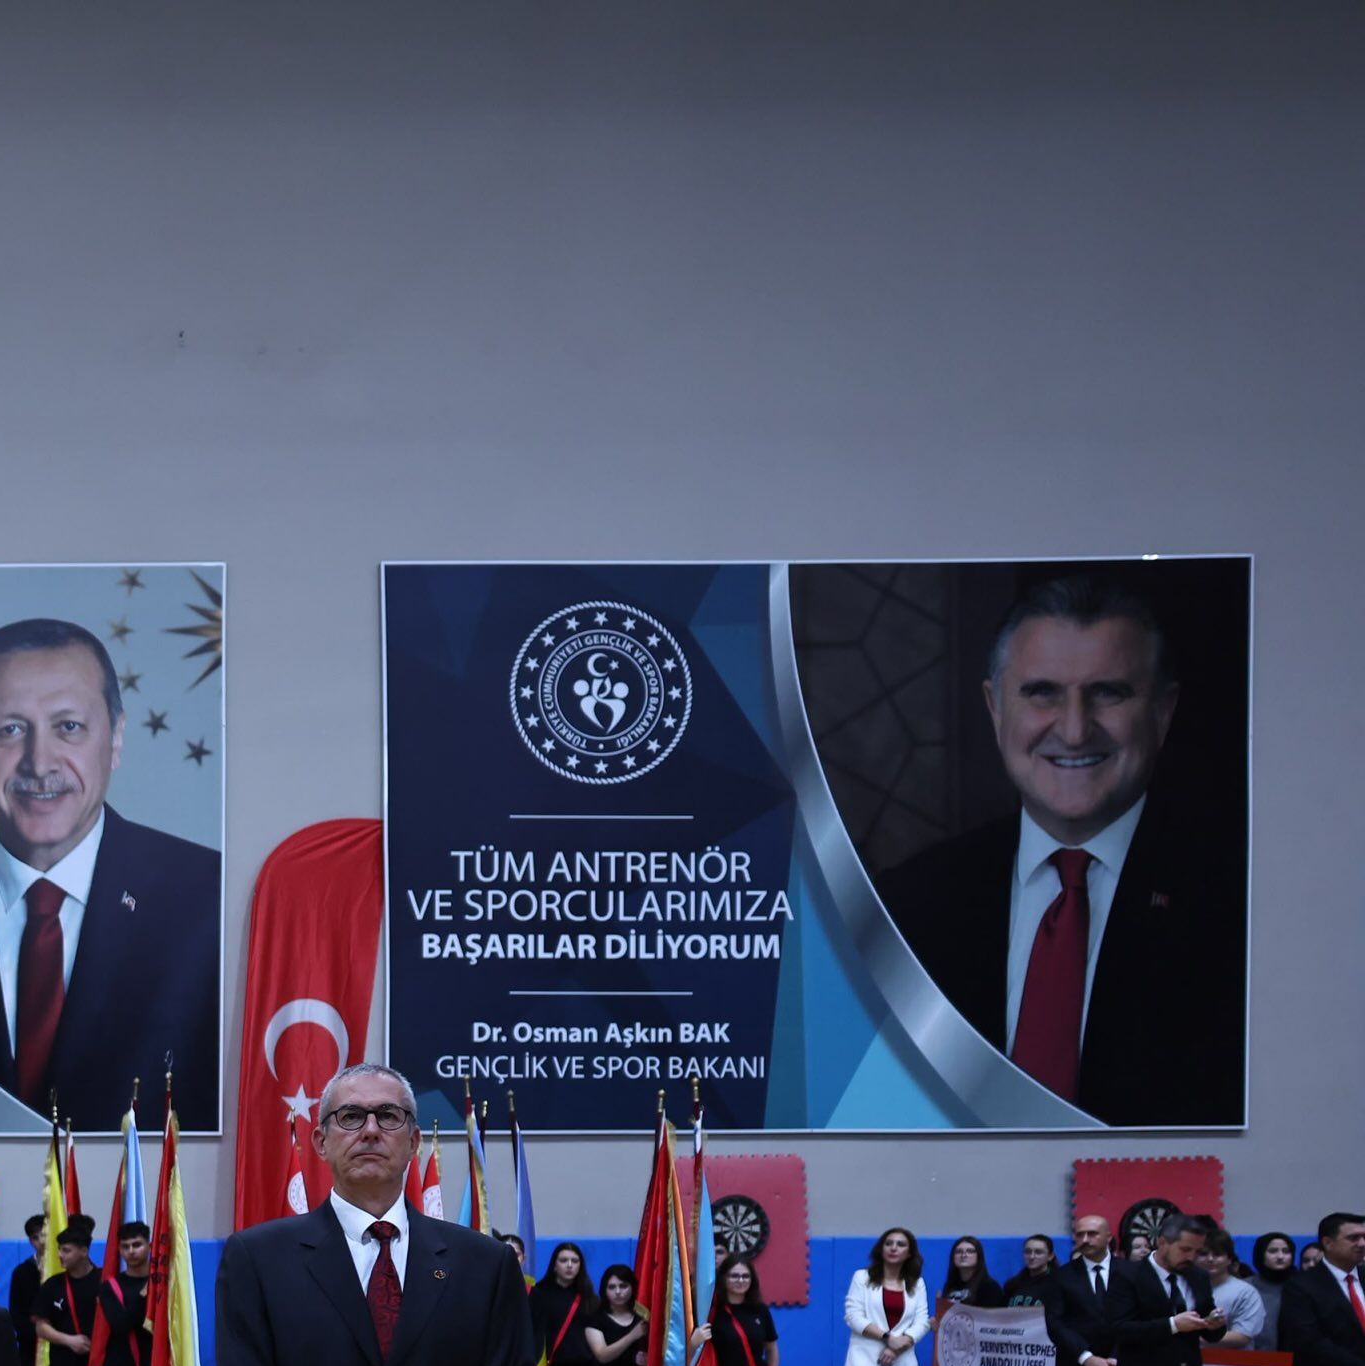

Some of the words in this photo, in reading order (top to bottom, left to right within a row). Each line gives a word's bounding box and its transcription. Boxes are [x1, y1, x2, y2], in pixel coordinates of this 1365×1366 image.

[584, 634, 635, 653] GENÇLİK
[633, 648, 647, 664] VE
[543, 637, 584, 710] CUMHURİYETİ
[643, 662, 660, 694] SPOR
[548, 710, 587, 749] TÜRKİYE
[450, 845, 535, 883] TÜM
[547, 845, 752, 883] ANTRENÖR
[407, 889, 453, 921] VE
[464, 889, 795, 922] SPORCULARIMIZA
[422, 933, 597, 965] BAŞARILAR
[604, 928, 781, 960] DİLİYORUM
[472, 1022, 507, 1043] Dr.
[513, 1022, 598, 1043] Osman
[604, 1021, 673, 1048] Aşkın
[679, 1022, 731, 1043] BAK
[436, 1051, 548, 1084] GENÇLİK
[552, 1056, 585, 1079] VE
[592, 1055, 661, 1079] SPOR
[668, 1055, 765, 1079] BAKANI
[1024, 1343, 1057, 1358] CEPHES
